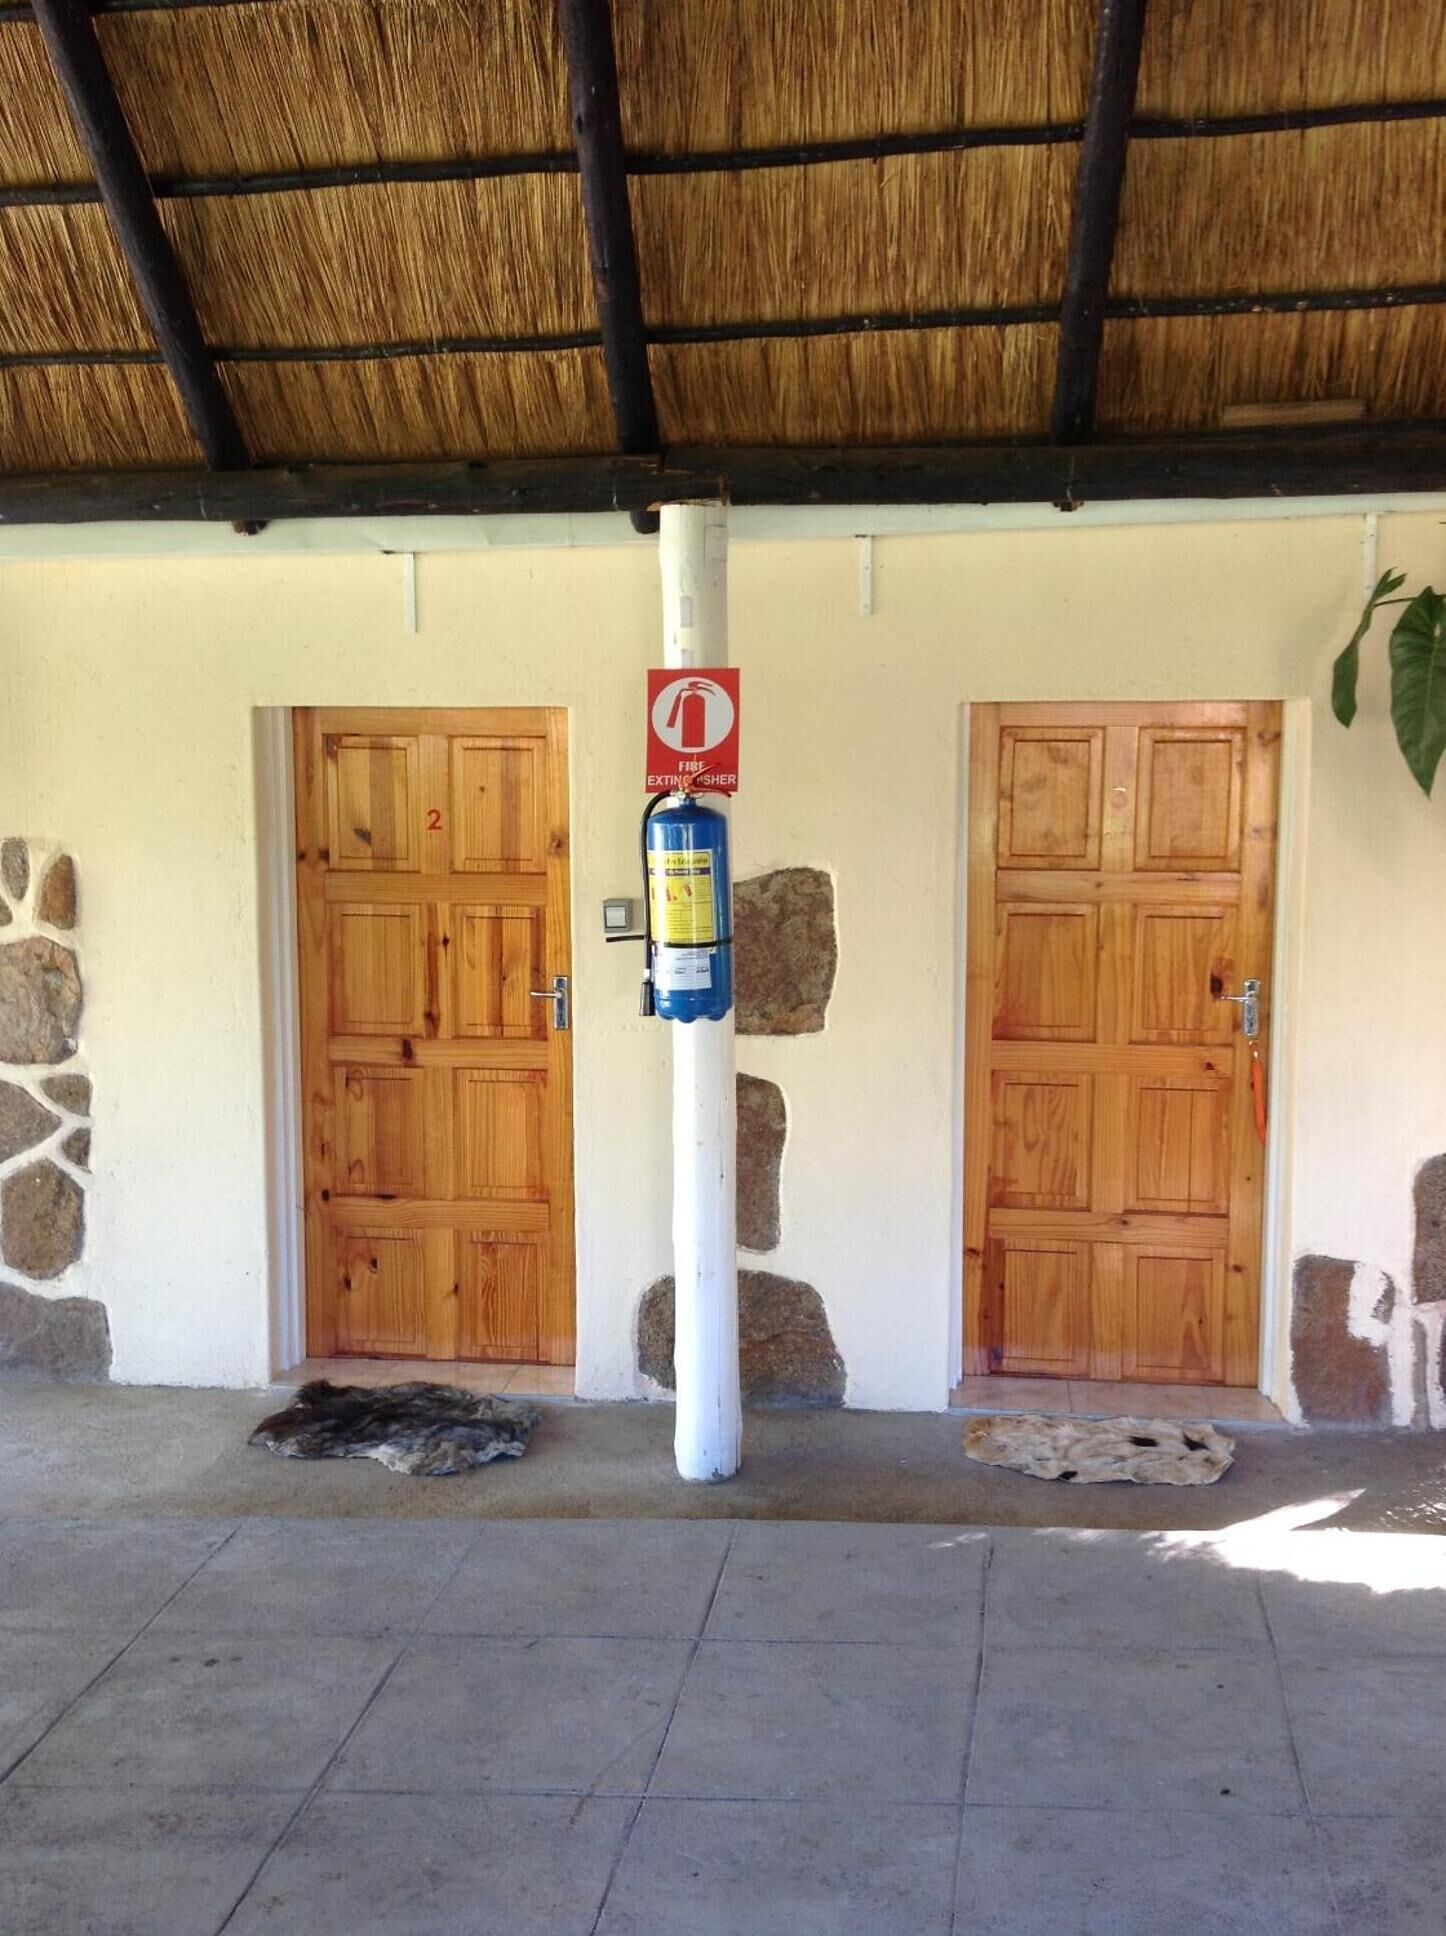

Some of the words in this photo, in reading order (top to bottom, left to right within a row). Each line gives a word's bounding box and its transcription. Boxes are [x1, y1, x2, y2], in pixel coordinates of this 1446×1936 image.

[678, 760, 706, 772] FIRE
[647, 773, 737, 786] EXTINISHER
[427, 808, 442, 831] 2
